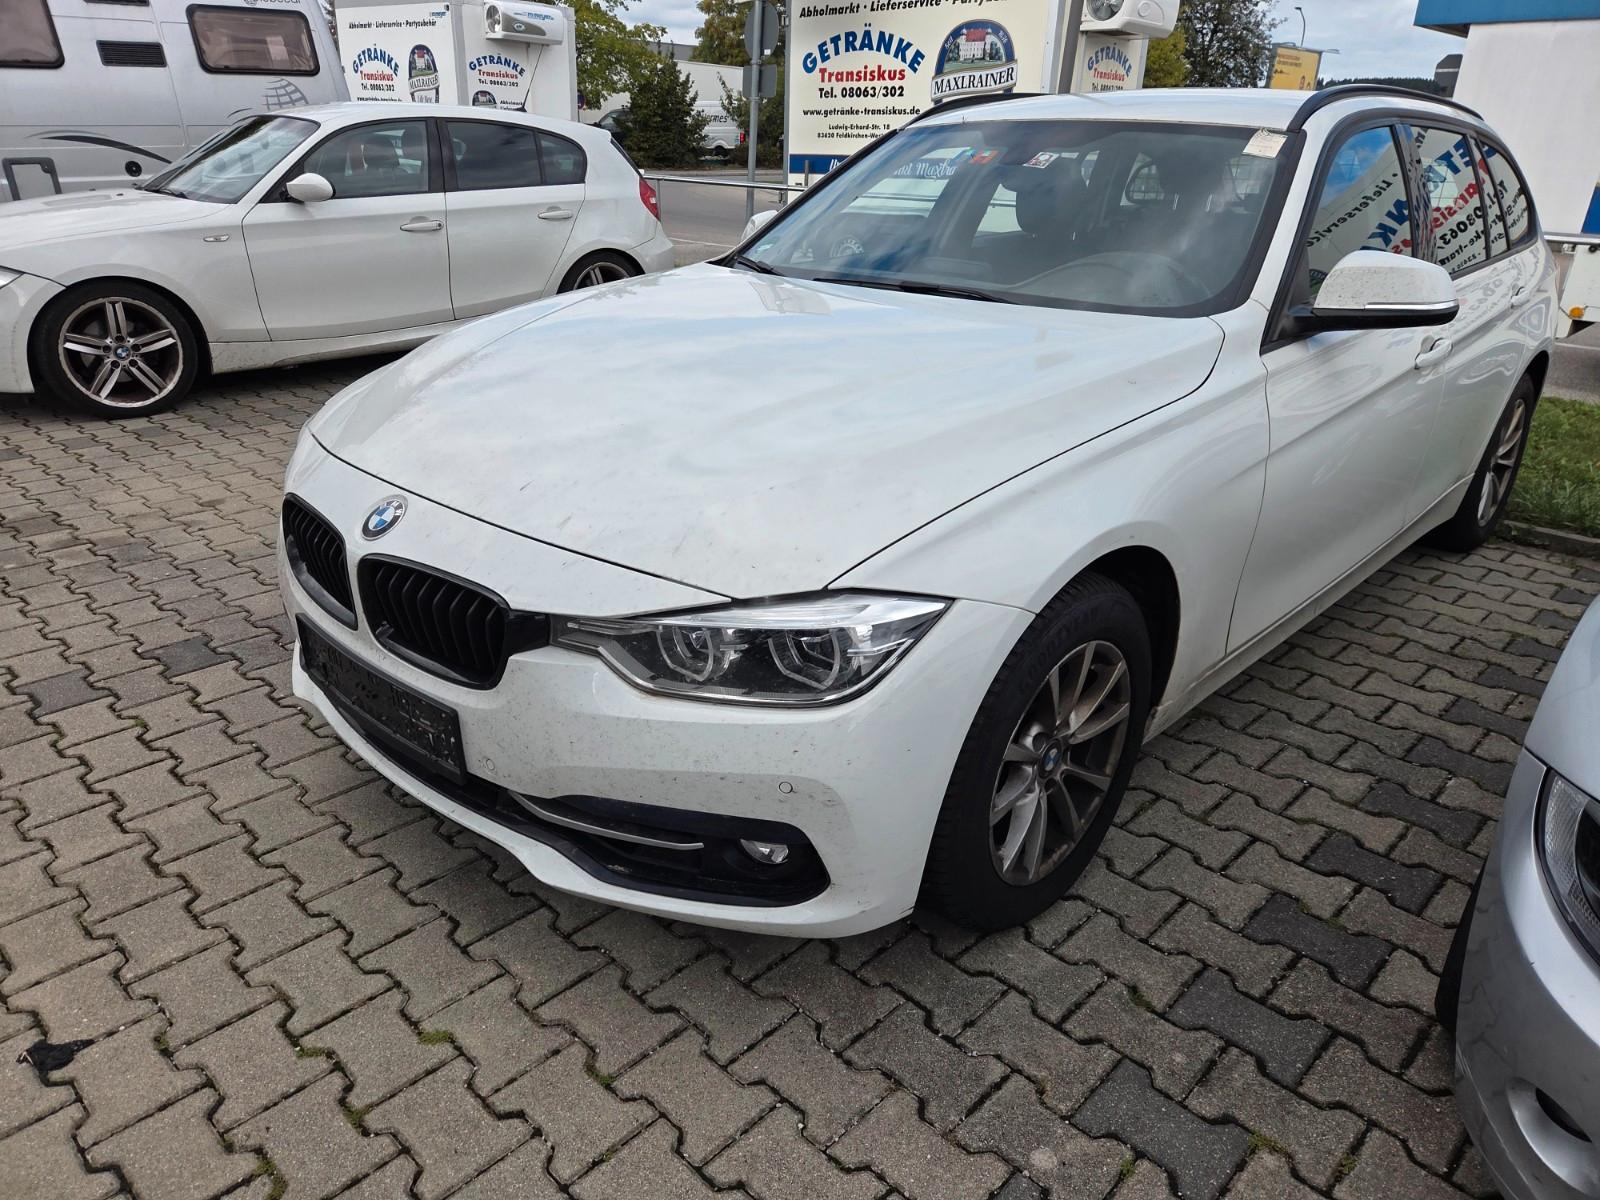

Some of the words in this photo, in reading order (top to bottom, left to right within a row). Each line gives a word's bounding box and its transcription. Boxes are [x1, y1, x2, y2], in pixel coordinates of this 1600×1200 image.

[799, 3, 860, 18] Abholmarkt
[870, 0, 941, 12] Lieferservice
[802, 23, 926, 75] GETRÄNKE
[352, 43, 400, 77] GETRÄNKE
[469, 53, 526, 77] GETRÄNKE
[1088, 42, 1132, 77] GETRÄNKE
[359, 70, 394, 82] Transiskus
[477, 69, 519, 80] Transiskus
[819, 65, 906, 83] Transiskus
[933, 66, 1014, 95] MAXLRAINER
[1093, 68, 1125, 82] Transiskus
[361, 82, 370, 91] Tel.
[818, 87, 838, 99] Tel.
[841, 85, 905, 99] 08063/302
[803, 106, 921, 117] www.getränke-transiskus.de
[828, 123, 881, 131] Ludwig-Erhard-Str.
